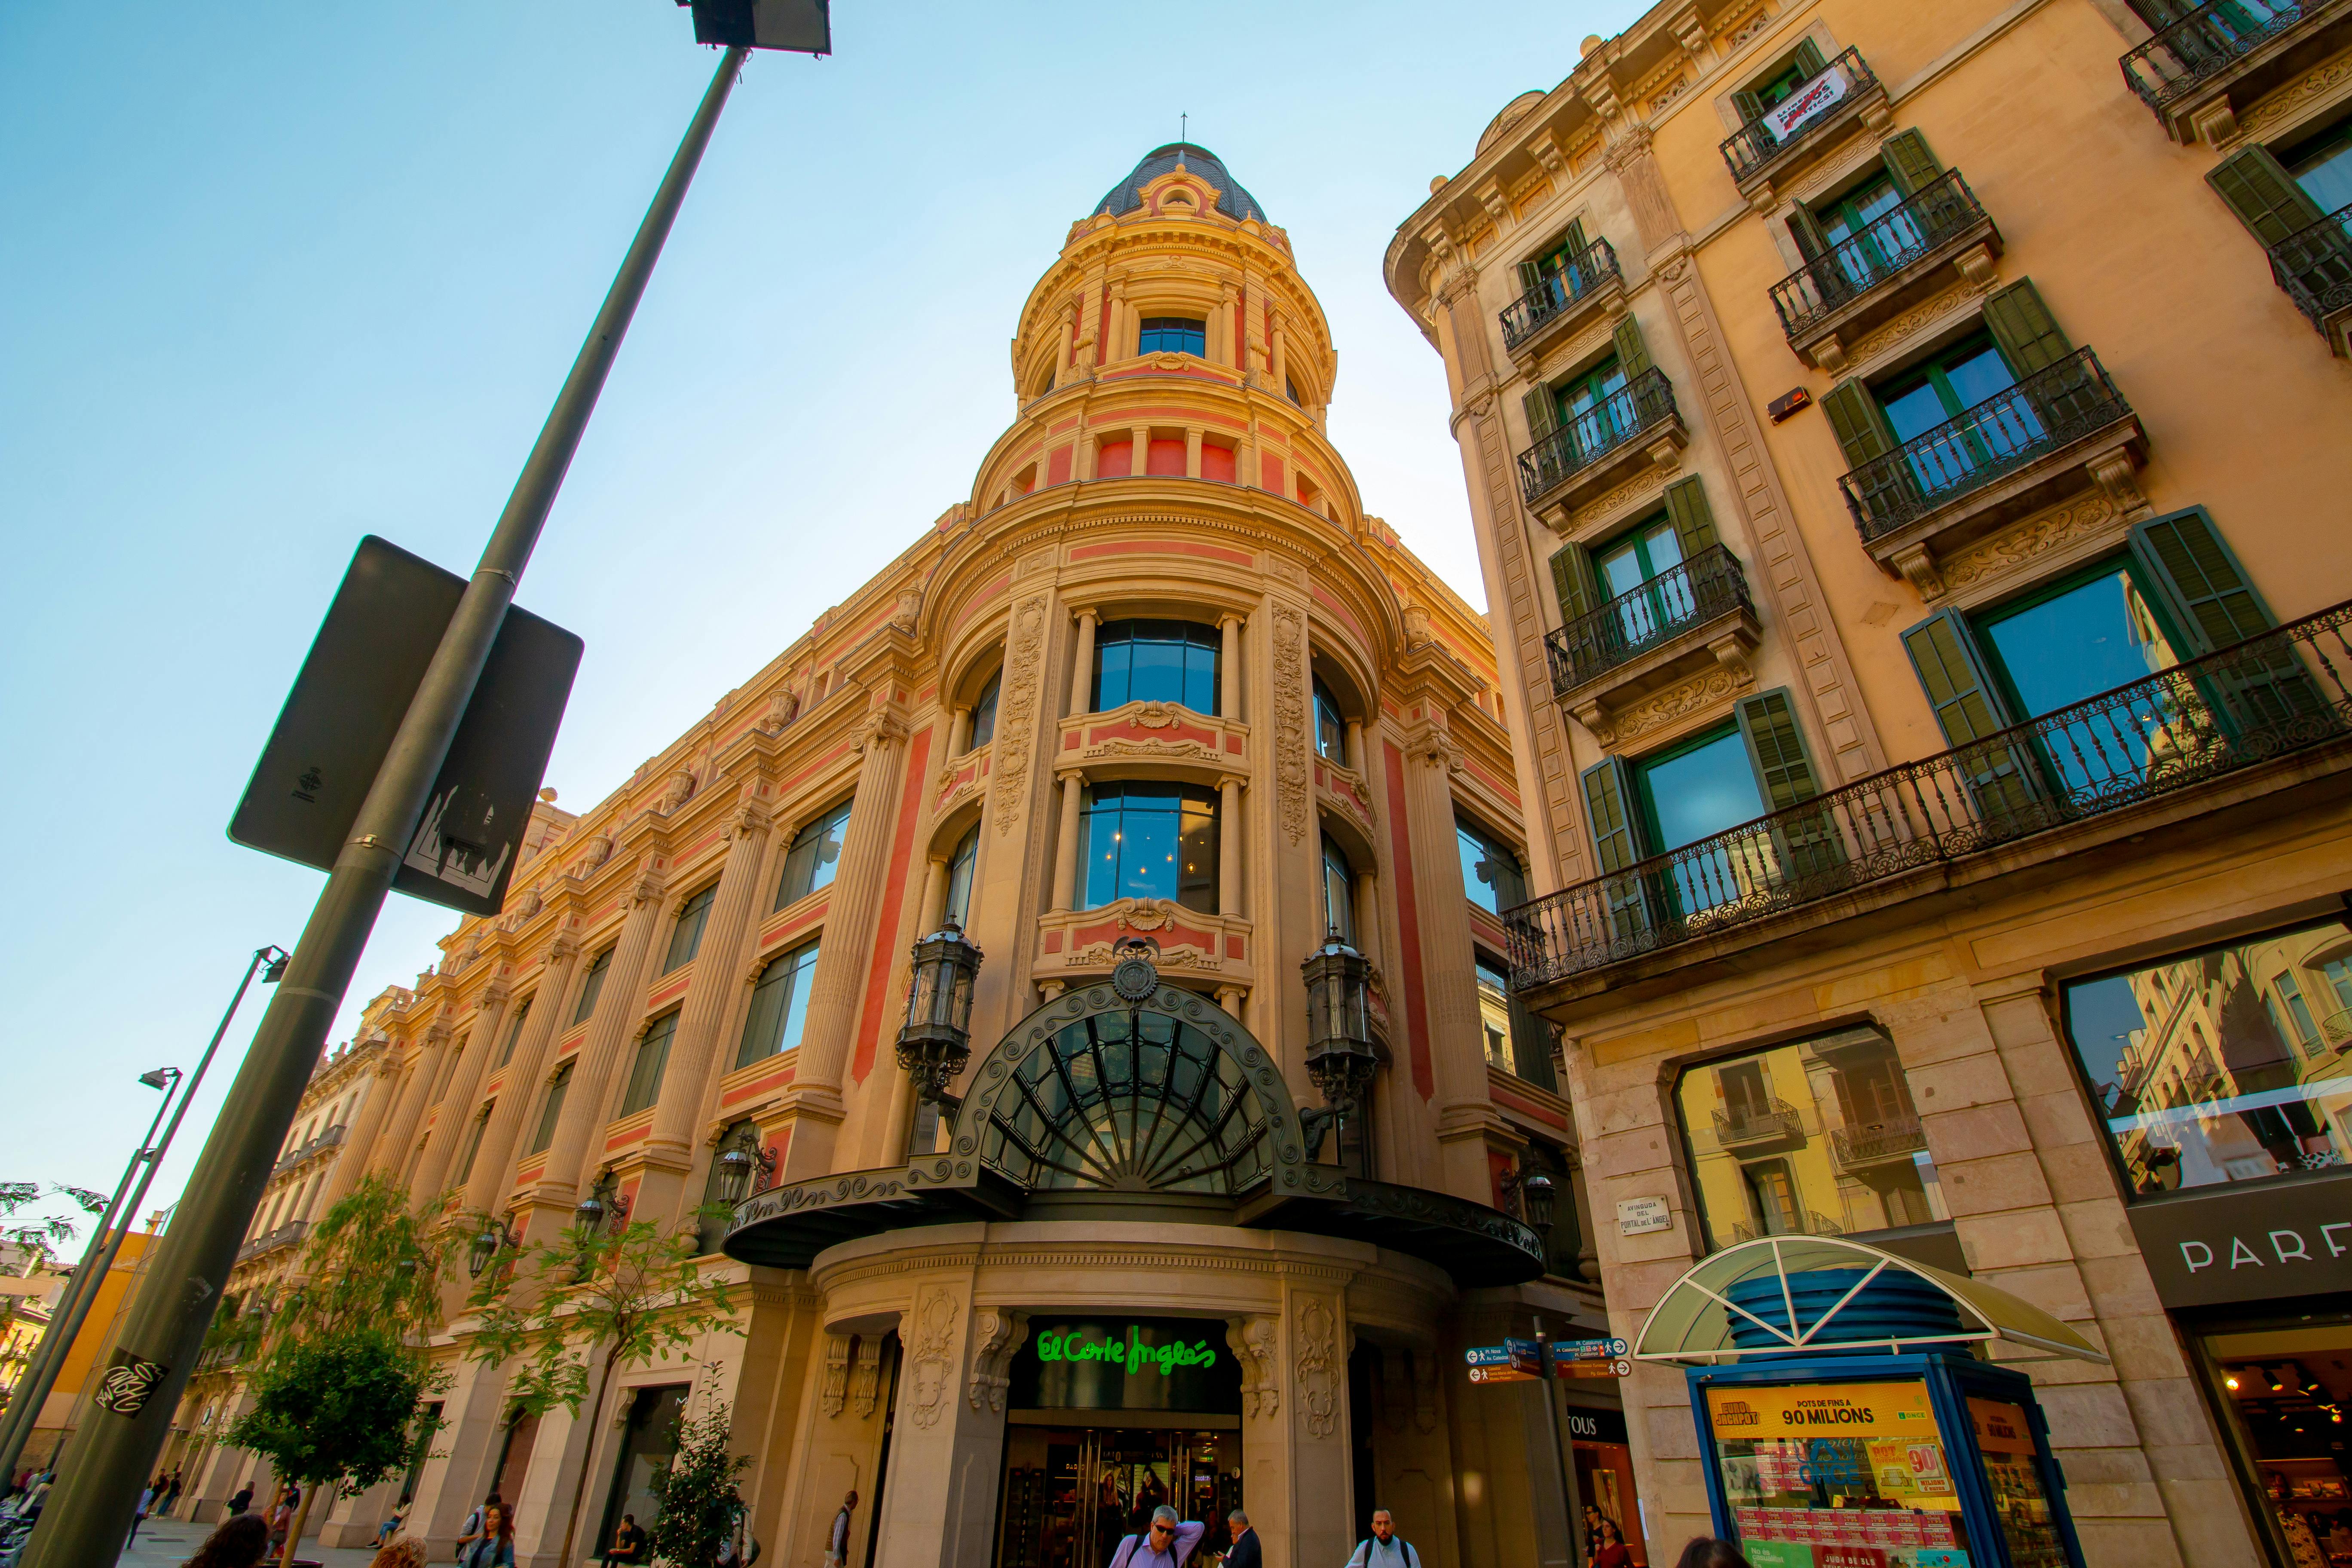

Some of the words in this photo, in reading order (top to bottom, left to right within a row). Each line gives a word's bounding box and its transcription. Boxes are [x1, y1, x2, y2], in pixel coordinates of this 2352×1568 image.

[1627, 1202, 1657, 1211] AVINGUDA
[1620, 1219, 1641, 1229] PORTAL
[2179, 1222, 2352, 1273] PARF
[1038, 1330, 1063, 1361] El
[1063, 1332, 1124, 1363] Corte
[1127, 1326, 1216, 1375] Inglés
[1721, 1402, 1748, 1413] EURO
[1782, 1409, 1805, 1425] 90
[1807, 1408, 1874, 1424] MILIONS
[1568, 1416, 1596, 1435] OUS
[1872, 1446, 1896, 1457] POT
[1908, 1448, 1936, 1473] 90
[1799, 1464, 1862, 1485] ONCE
